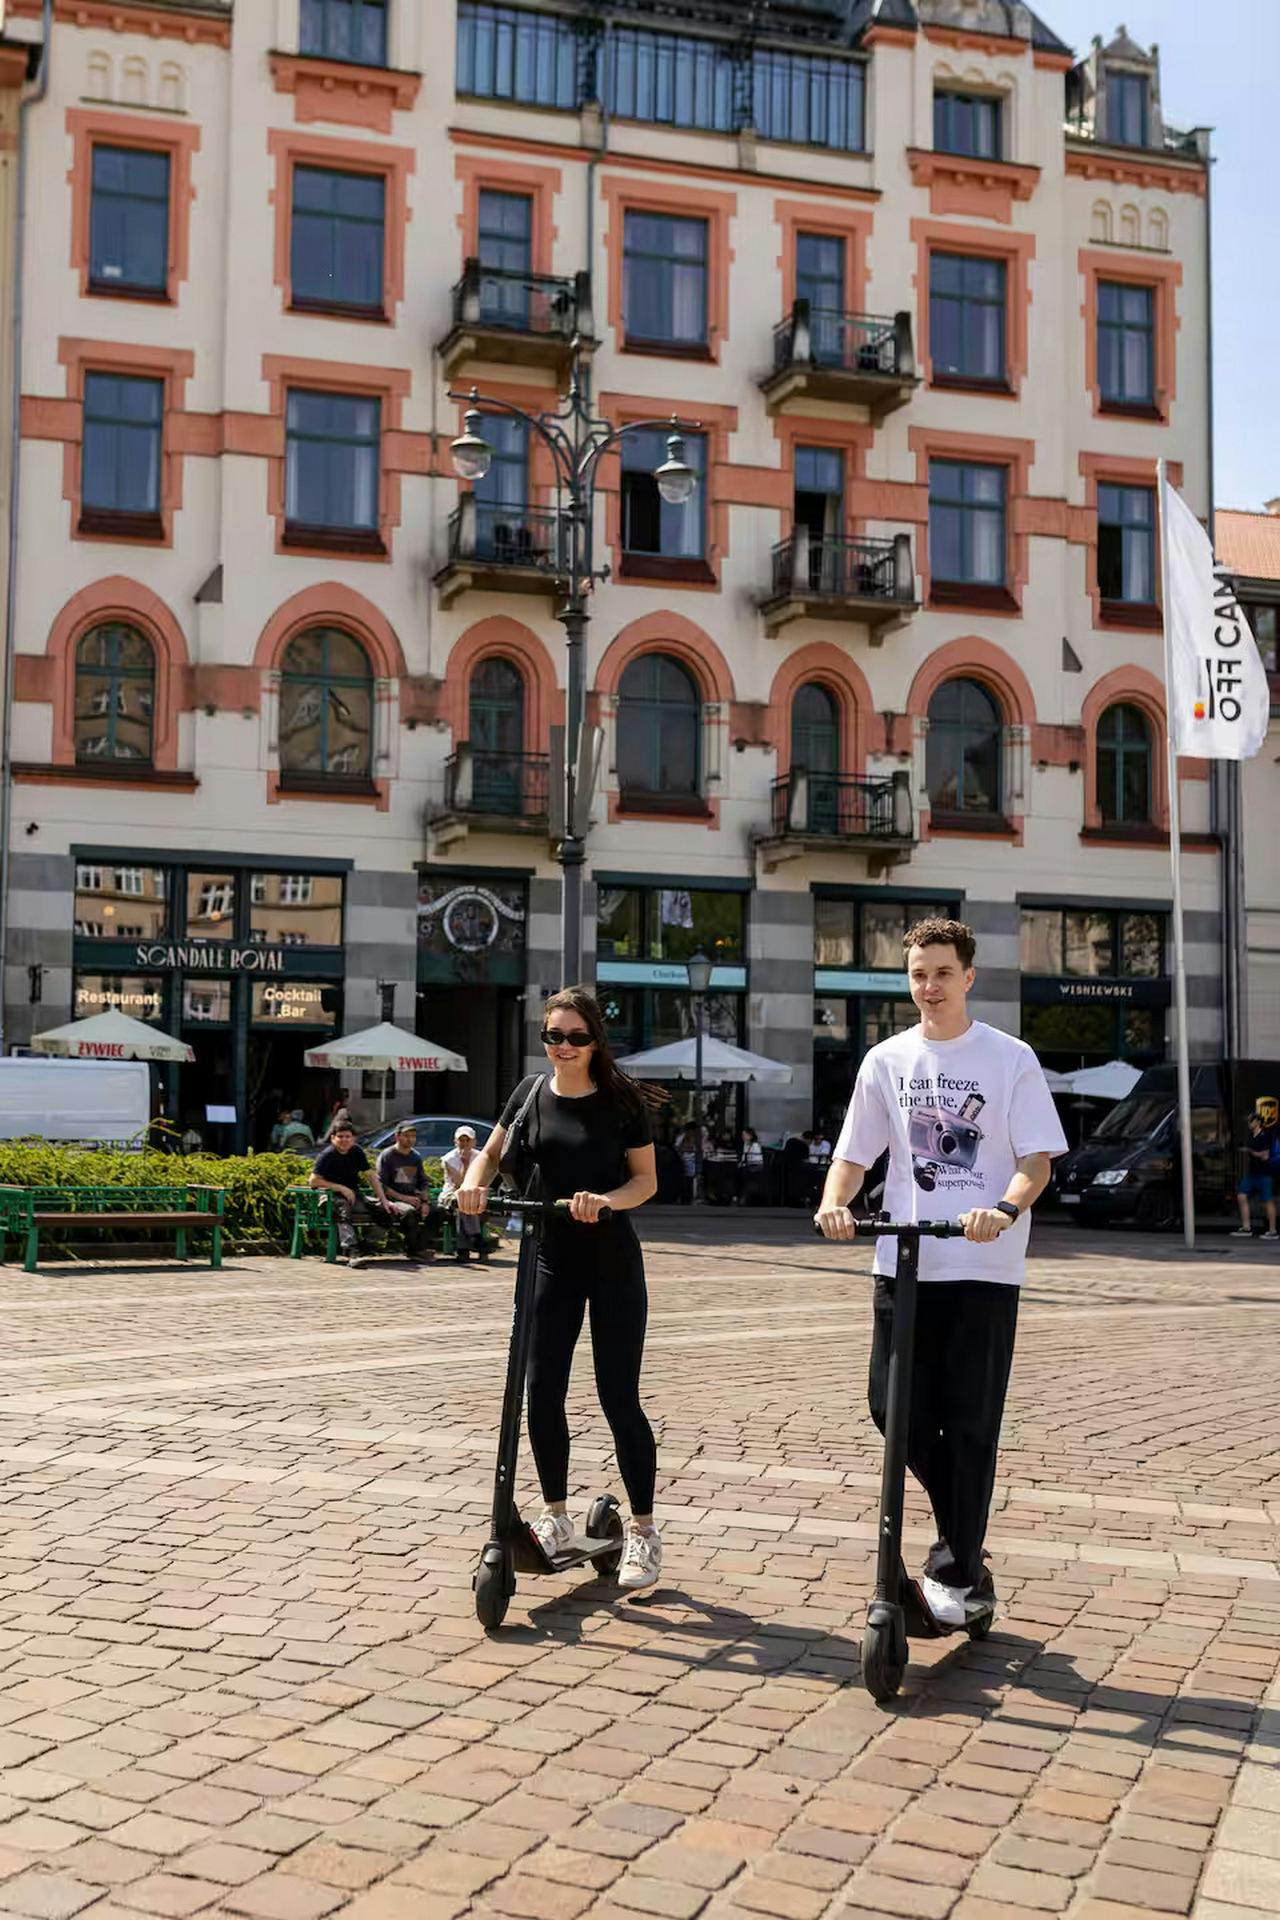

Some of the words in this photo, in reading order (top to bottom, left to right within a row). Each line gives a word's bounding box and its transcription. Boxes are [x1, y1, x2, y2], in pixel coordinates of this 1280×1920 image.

[1212, 557, 1241, 648] CAM
[1216, 658, 1242, 722] OFF
[136, 945, 225, 968] SCANDALE
[230, 949, 285, 971] ROYAL
[78, 989, 162, 1005] Restaurant
[264, 988, 322, 1002] Cocktail
[281, 1004, 306, 1017] Bar
[899, 1077, 904, 1091] I
[909, 1078, 933, 1090] can
[937, 1073, 980, 1092] freeze
[899, 1093, 921, 1107] the
